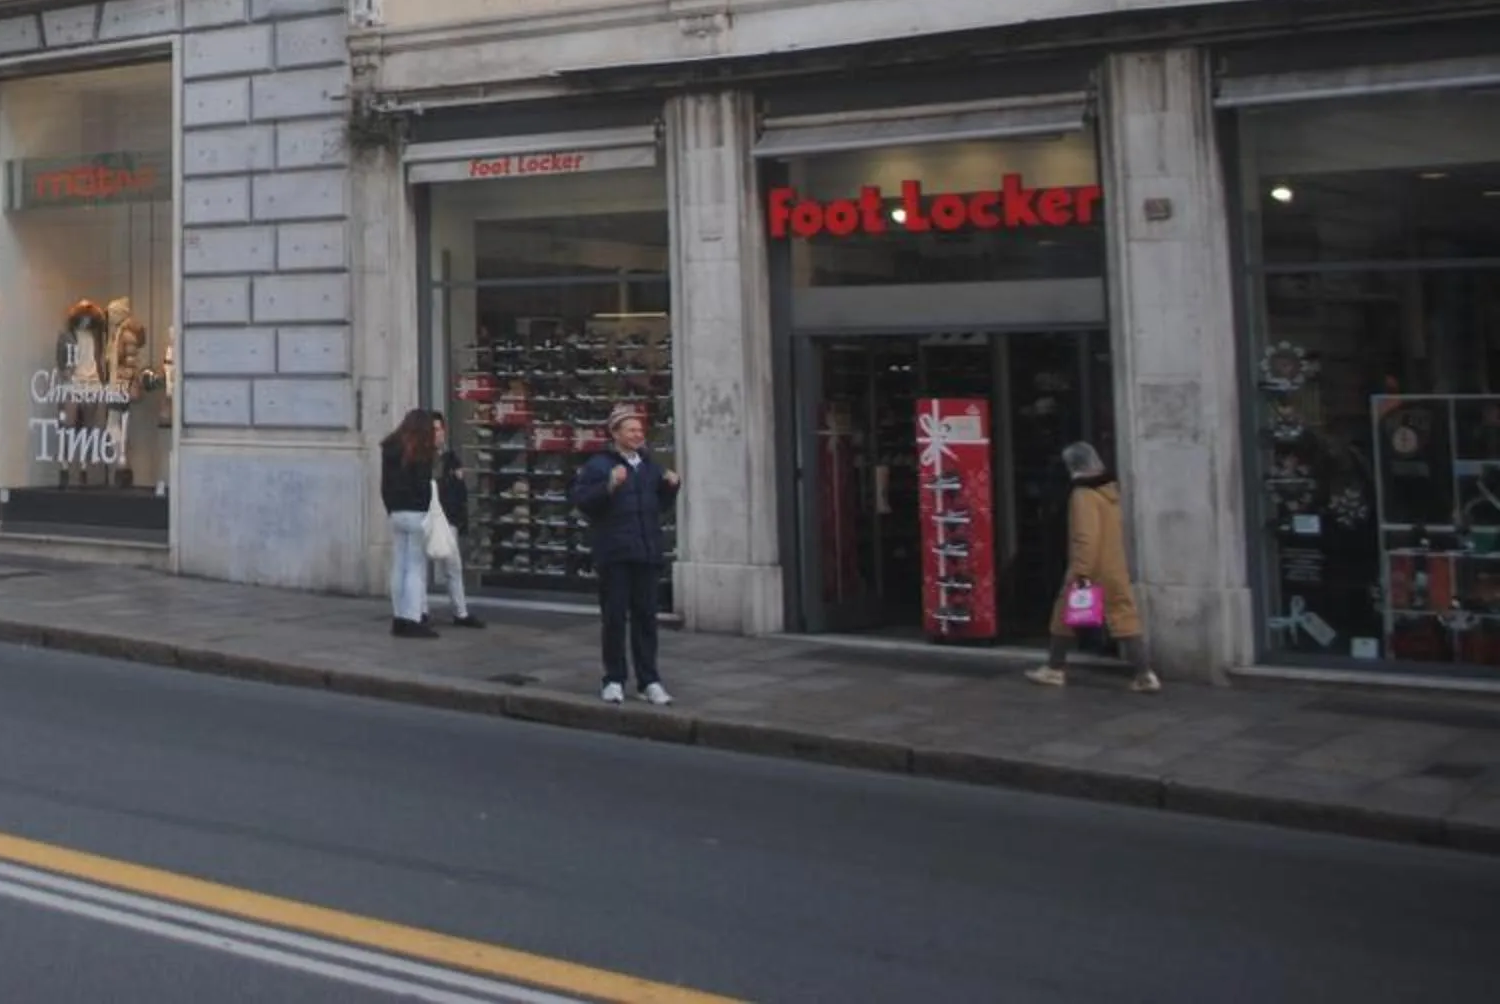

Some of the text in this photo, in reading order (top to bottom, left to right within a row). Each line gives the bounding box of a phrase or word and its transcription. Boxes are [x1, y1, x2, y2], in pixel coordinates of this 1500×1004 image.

[468, 152, 585, 178] Foot Locker
[768, 185, 886, 239] Foot
[902, 173, 1100, 233] Locker
[29, 411, 129, 465] Time!
